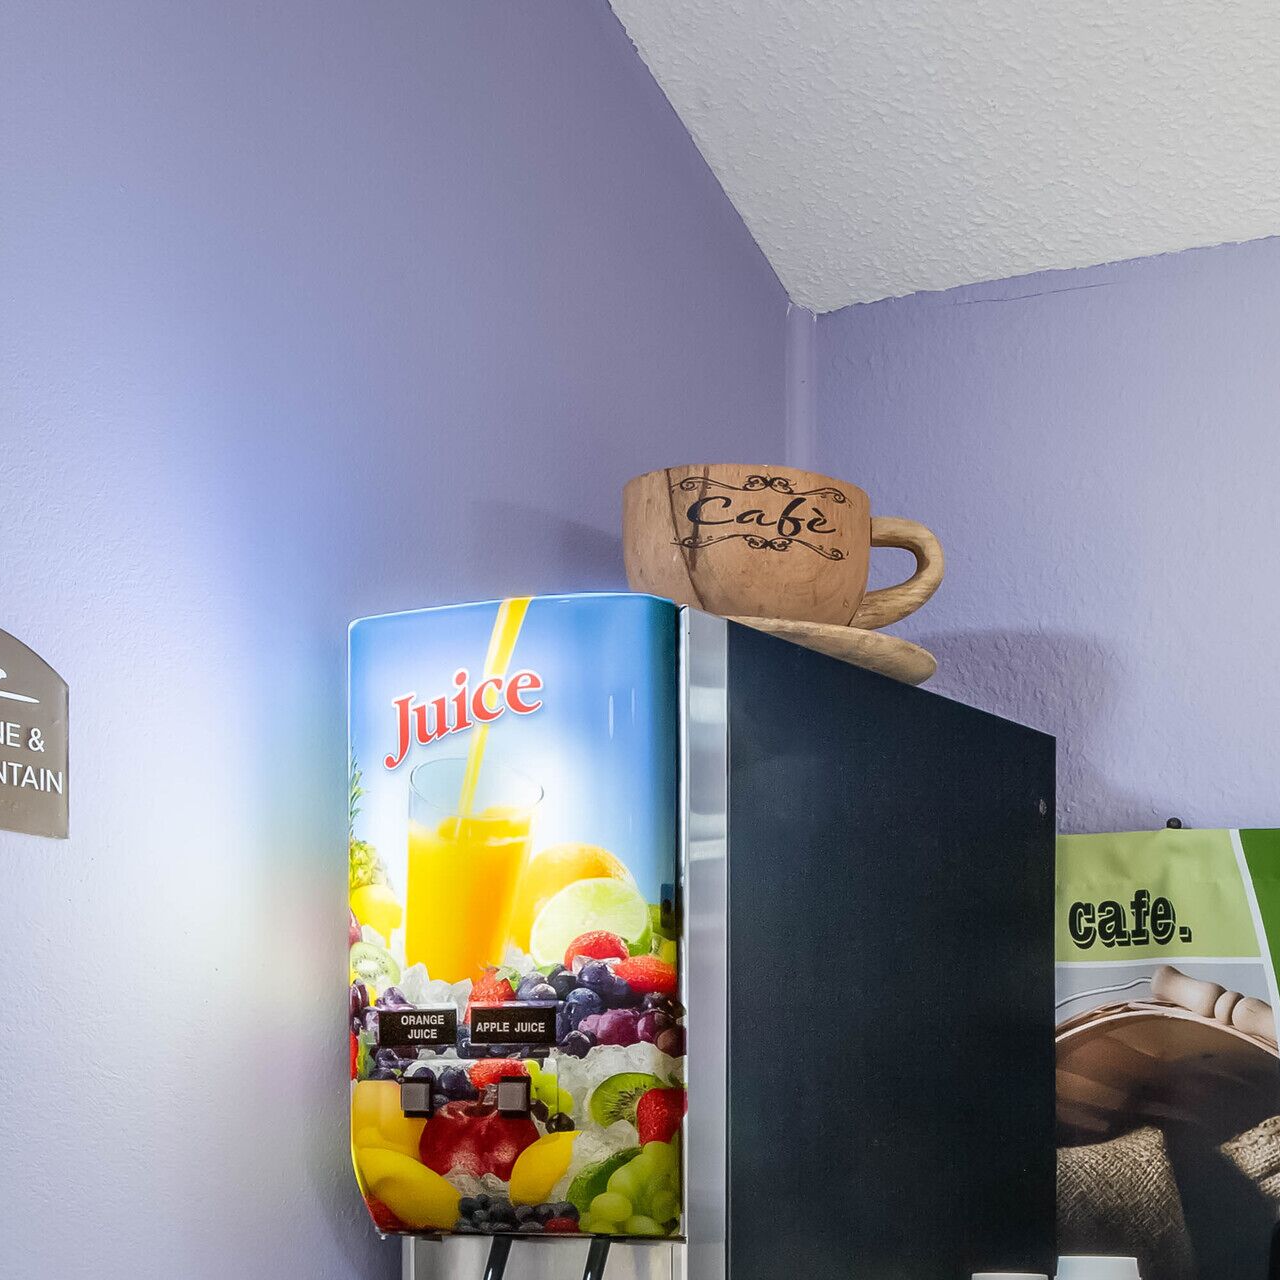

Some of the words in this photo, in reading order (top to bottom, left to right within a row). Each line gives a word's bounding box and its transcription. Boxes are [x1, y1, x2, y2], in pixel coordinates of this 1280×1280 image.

[384, 669, 542, 769] Juice
[28, 727, 45, 753] &
[1068, 889, 1192, 950] cafe.
[400, 1014, 444, 1026] ORANGE
[475, 1022, 510, 1033] APPLE
[514, 1022, 546, 1033] JUICE
[407, 1028, 438, 1039] JUICE
